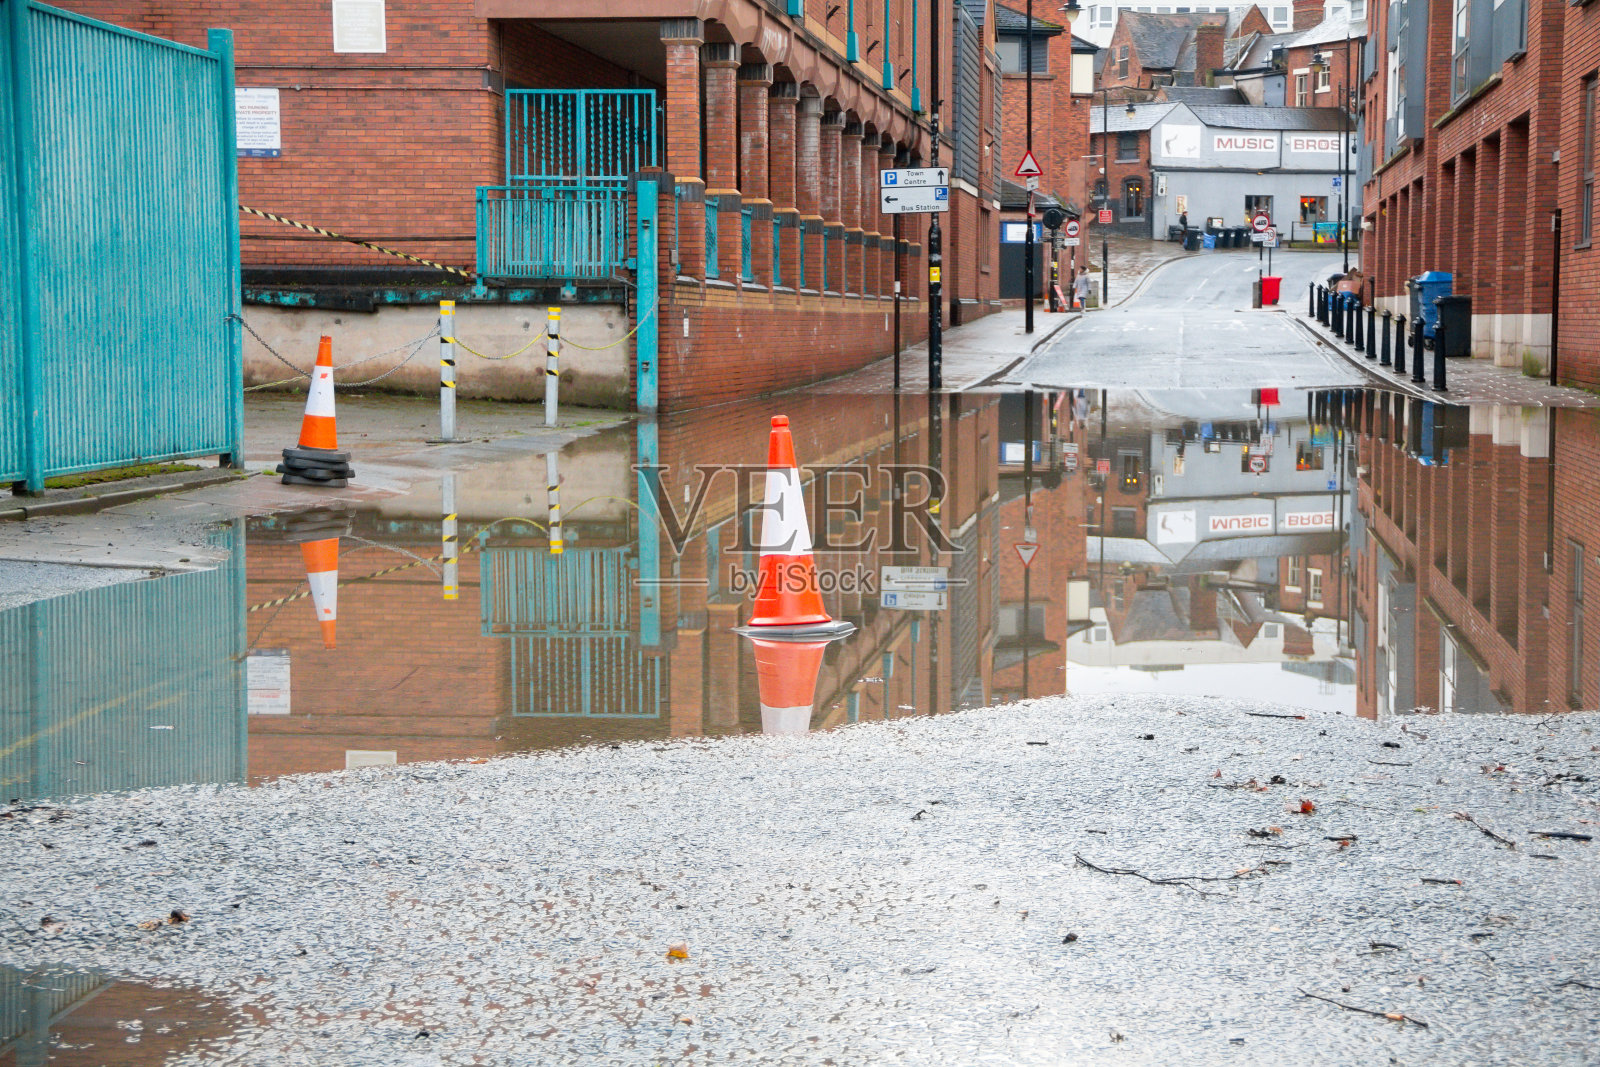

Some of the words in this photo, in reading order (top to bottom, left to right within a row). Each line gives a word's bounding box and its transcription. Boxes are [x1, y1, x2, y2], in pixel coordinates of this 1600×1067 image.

[1216, 138, 1274, 149] MUSIC
[1293, 139, 1340, 150] BROS
[887, 174, 896, 184] P
[936, 188, 943, 198] P
